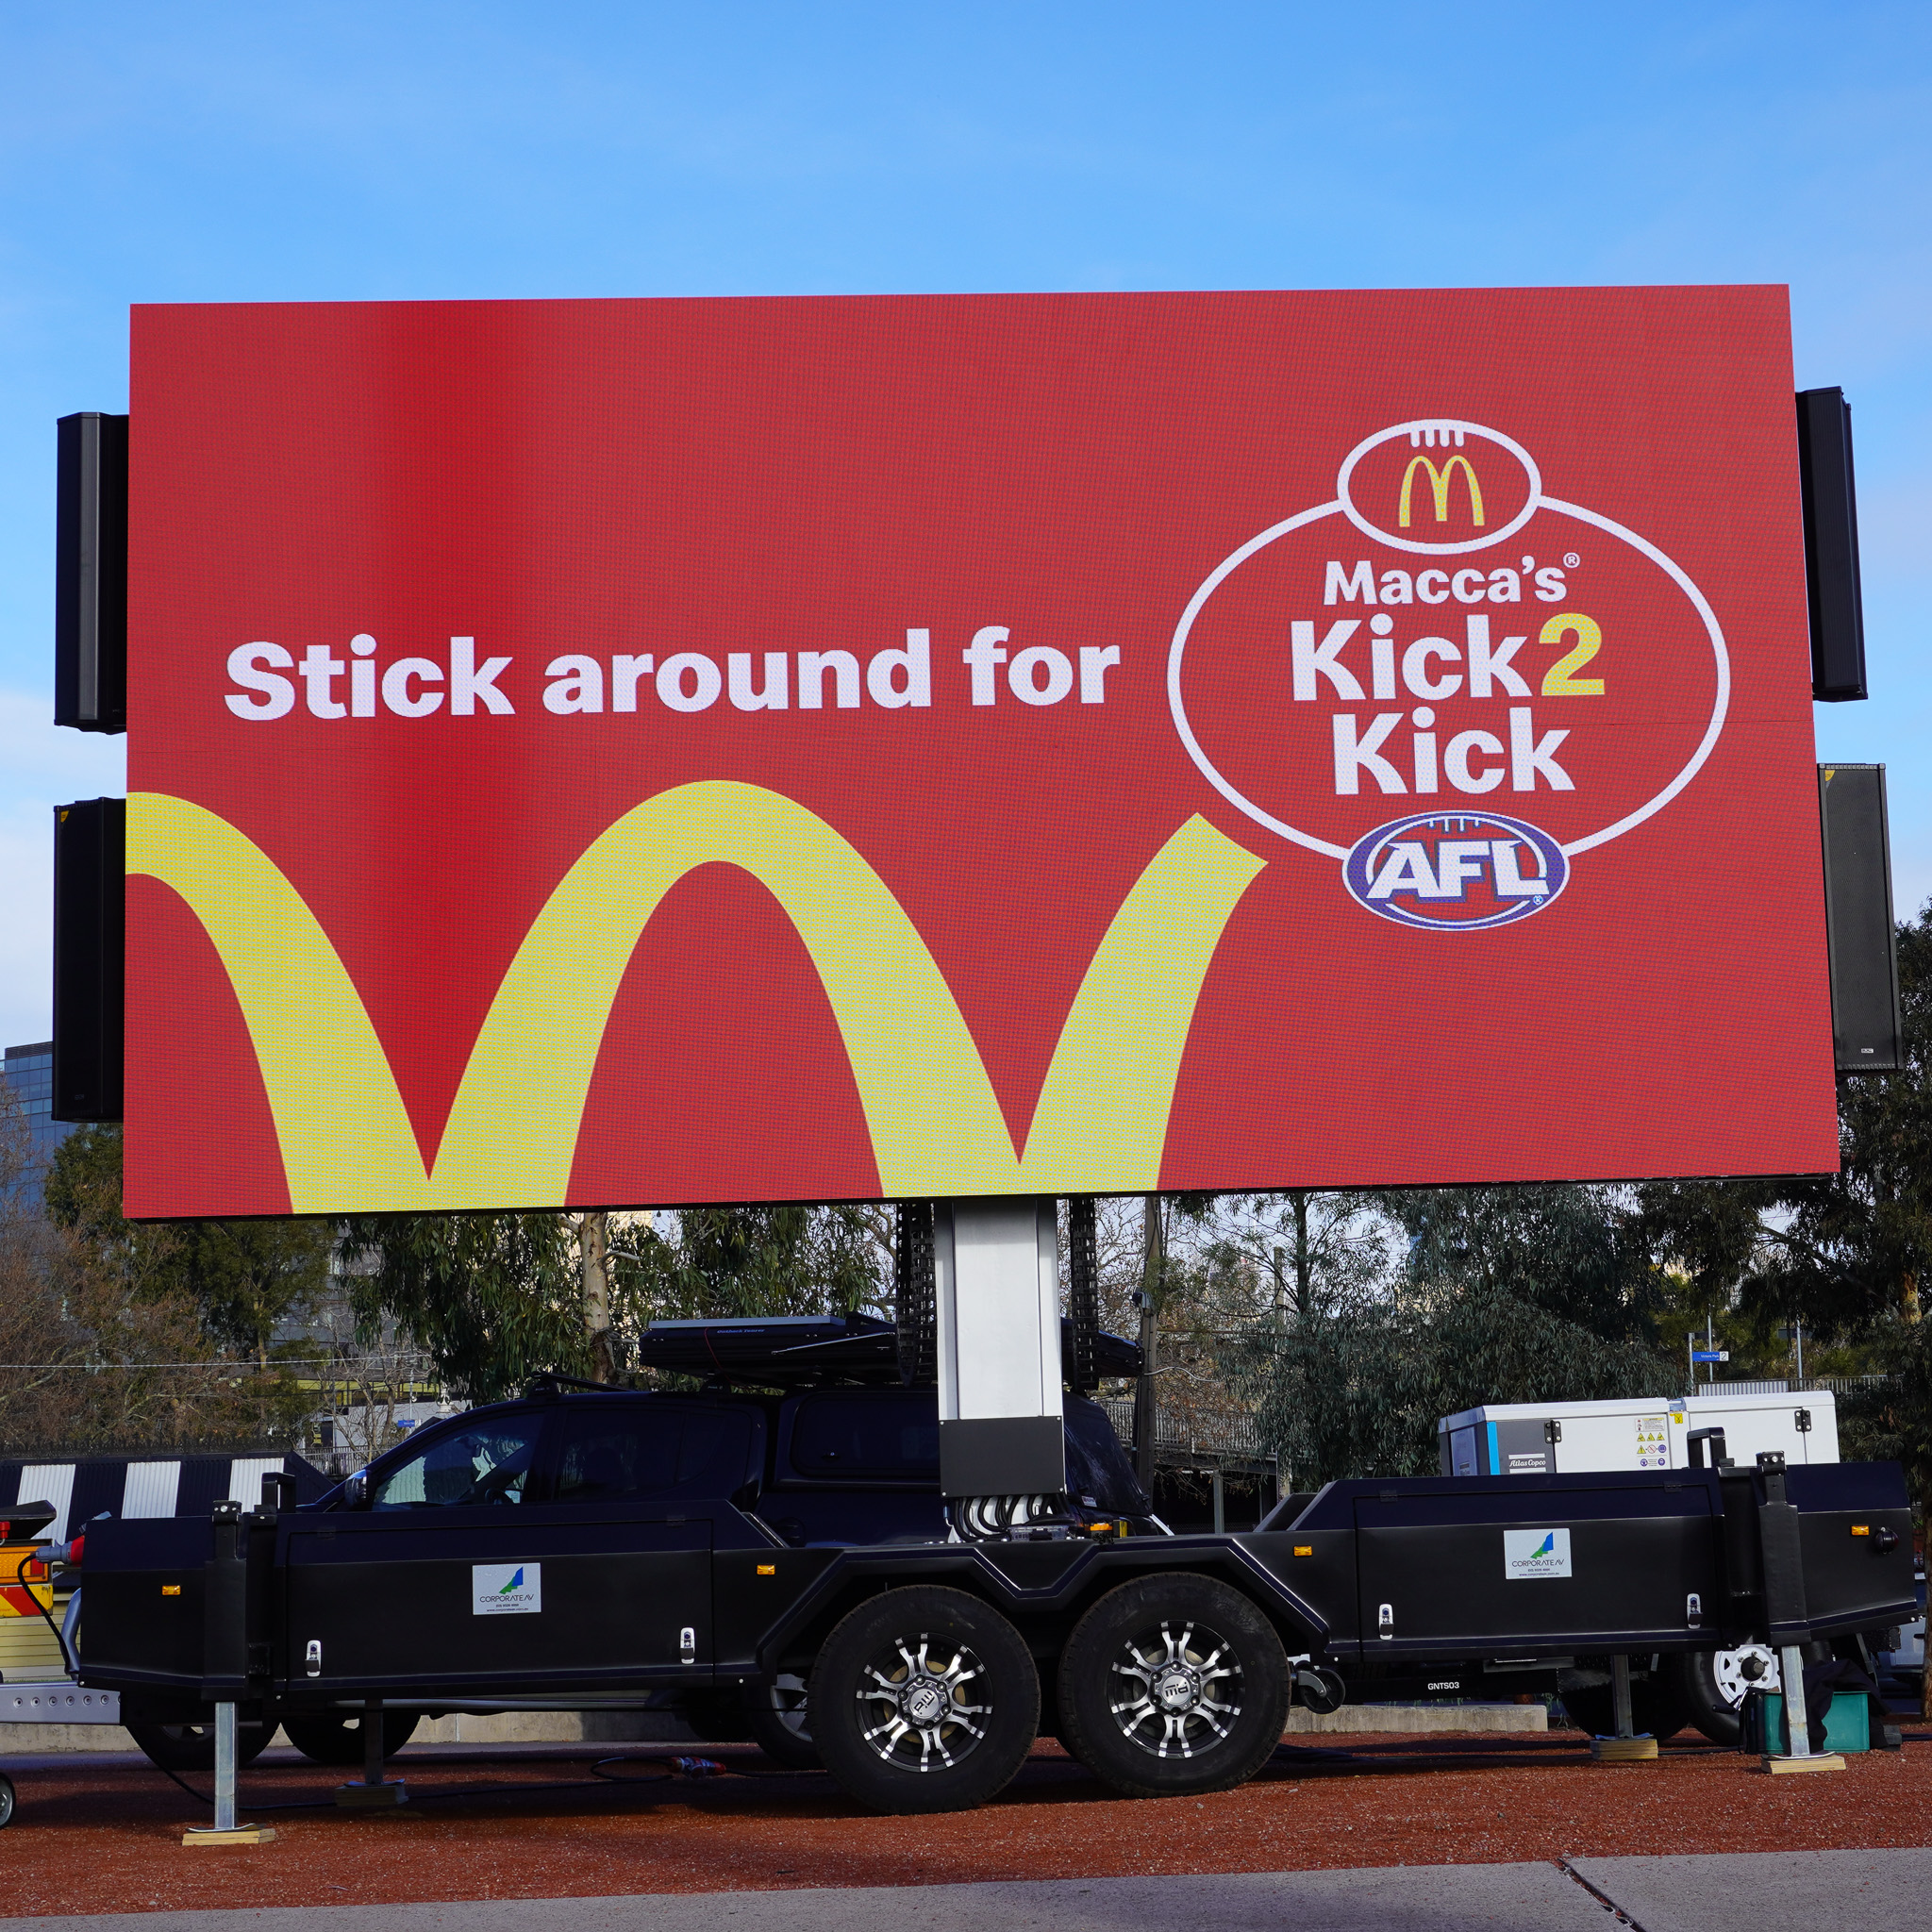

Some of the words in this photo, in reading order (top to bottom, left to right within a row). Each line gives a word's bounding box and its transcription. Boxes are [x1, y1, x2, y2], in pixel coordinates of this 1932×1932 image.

[225, 634, 515, 721] Stick
[542, 628, 931, 715] around
[962, 626, 1121, 707] for
[1333, 707, 1575, 795] Kick
[1366, 840, 1550, 898] AFL
[1721, 1352, 1727, 1360] 2
[1509, 1459, 1528, 1468] Atlas
[1528, 1458, 1546, 1468] Copco
[479, 1594, 524, 1603] CORPORATE
